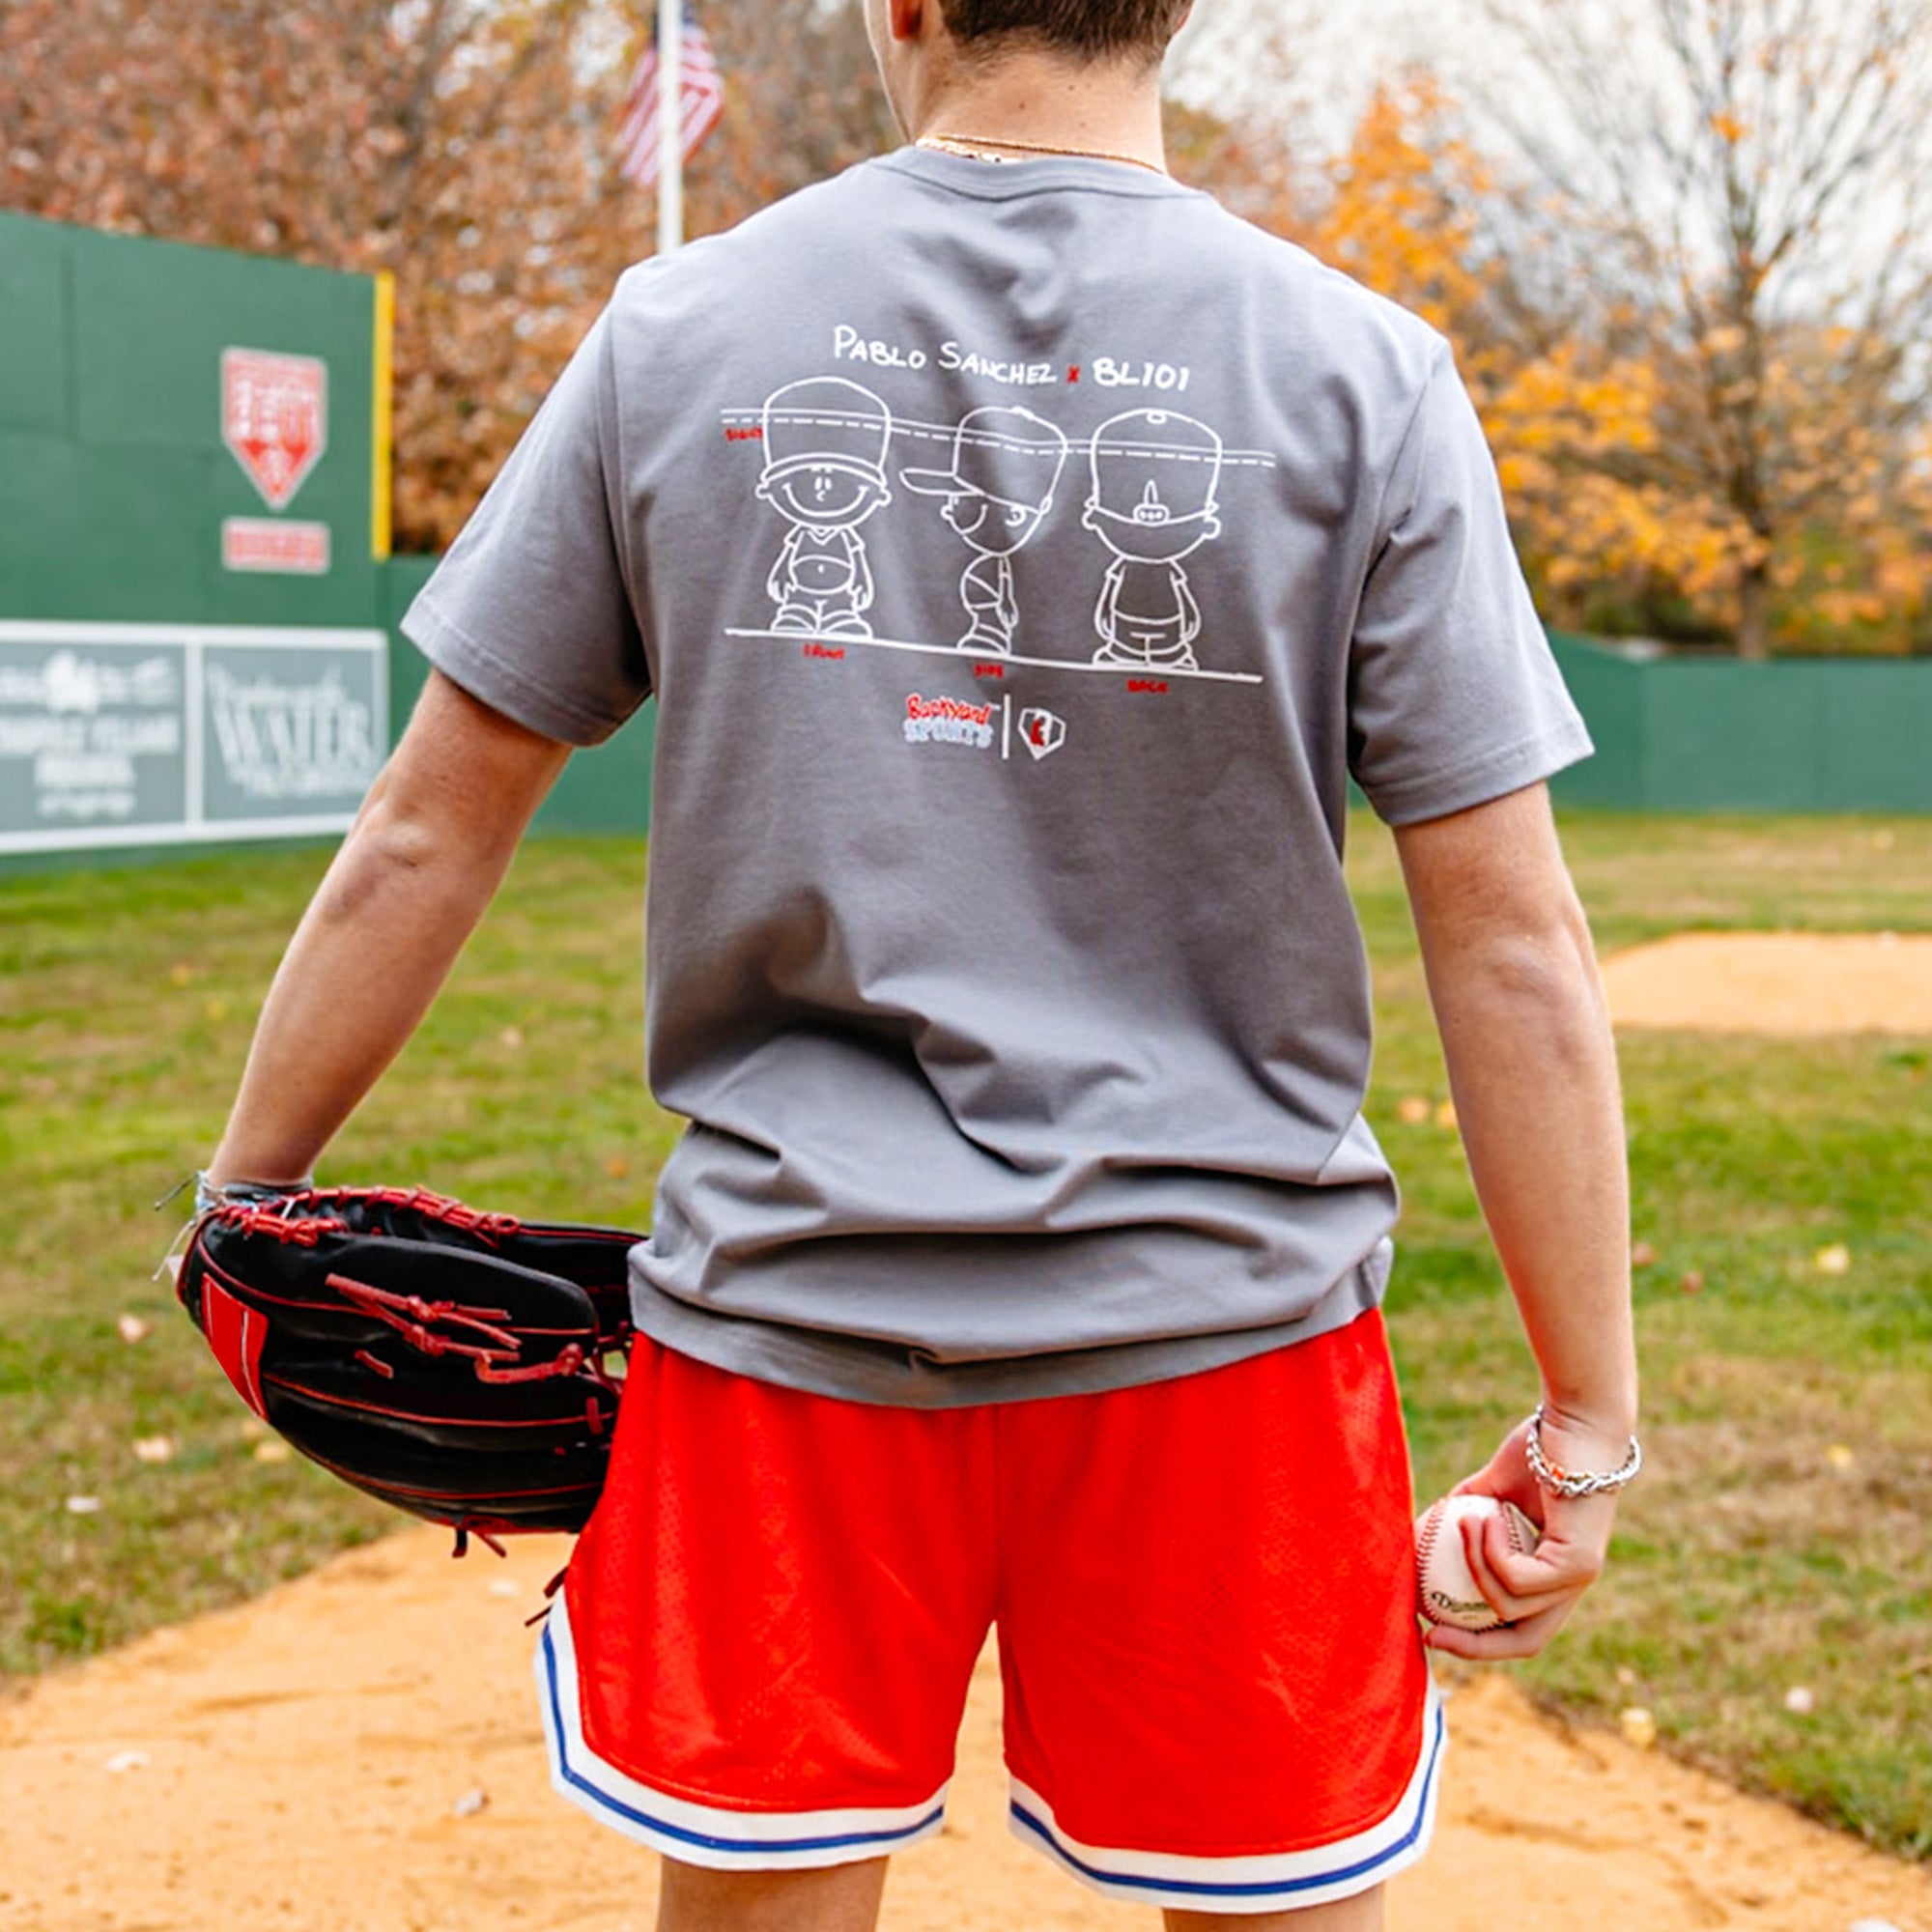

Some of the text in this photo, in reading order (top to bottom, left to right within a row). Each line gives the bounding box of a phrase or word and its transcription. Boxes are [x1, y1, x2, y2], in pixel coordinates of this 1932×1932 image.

[834, 325, 926, 369] PABLO
[939, 341, 1058, 384] SANCHEZ
[1092, 357, 1190, 391] BL101
